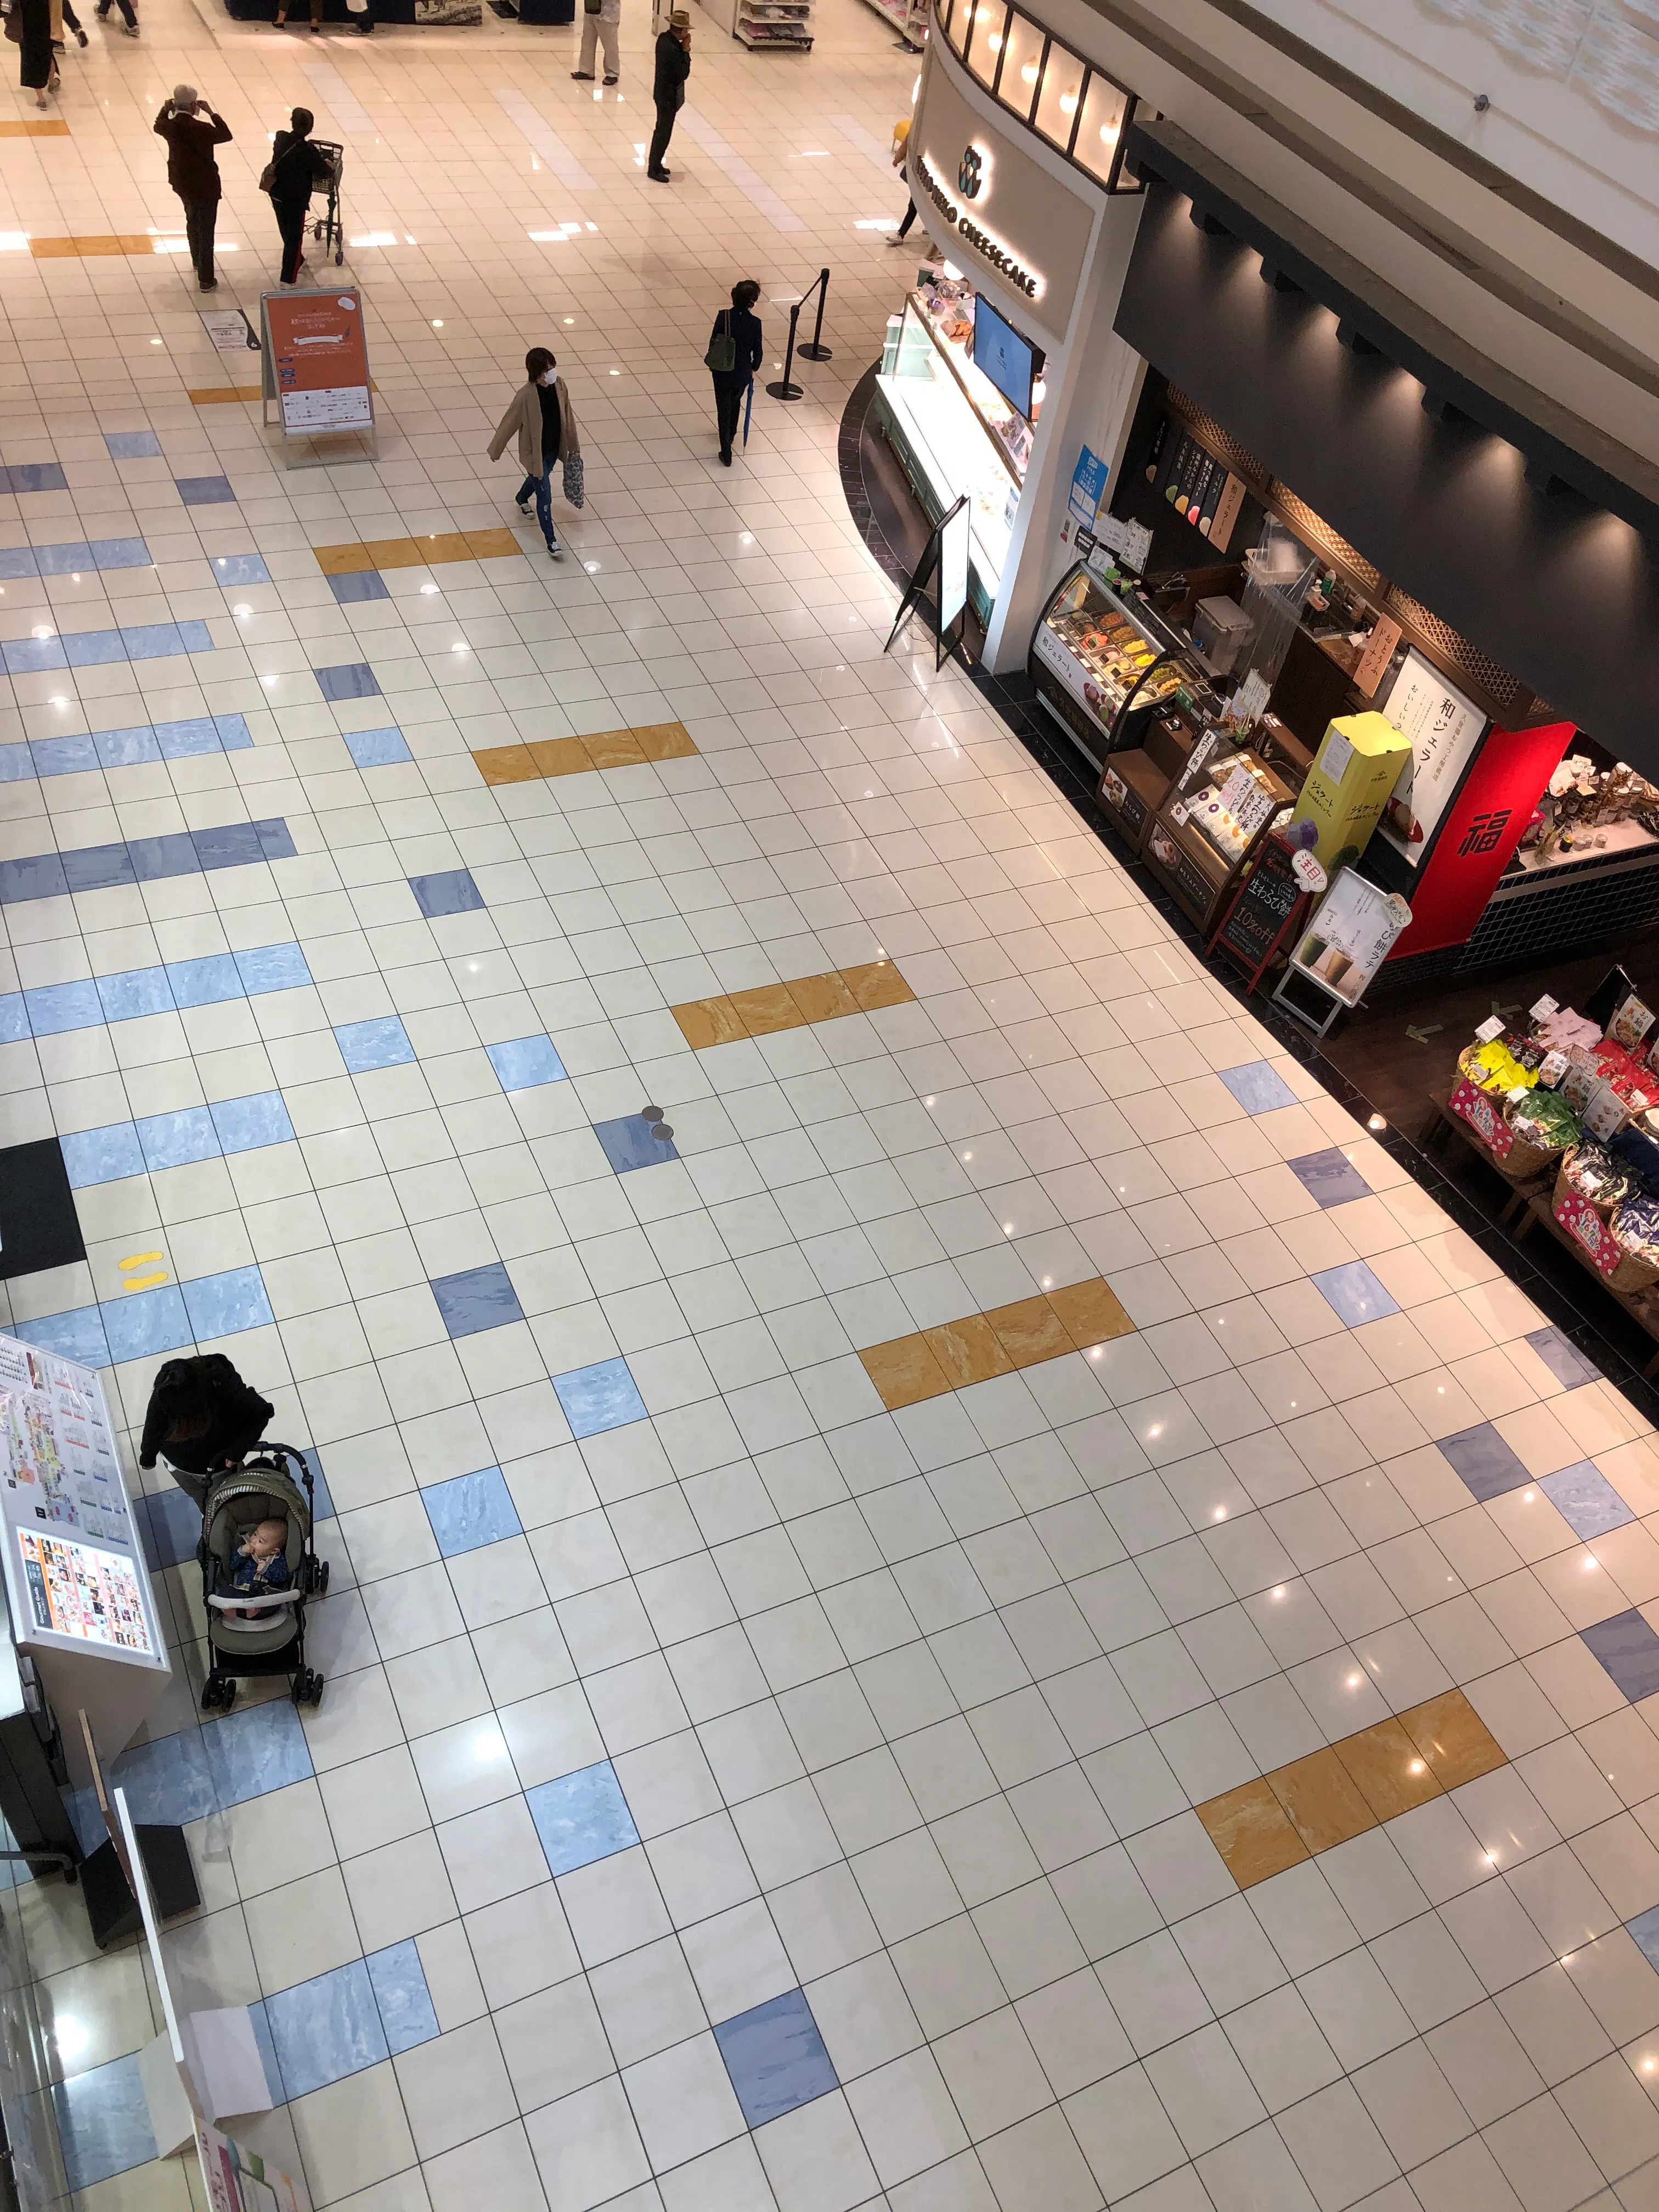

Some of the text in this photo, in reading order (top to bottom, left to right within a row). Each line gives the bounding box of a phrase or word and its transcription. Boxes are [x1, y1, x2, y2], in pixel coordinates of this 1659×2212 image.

[959, 218, 1036, 297] CHEESECAKE
[1042, 636, 1070, 672] 和ジェラート
[1364, 628, 1387, 667] ドーナツ
[1370, 635, 1393, 675] おとうふ
[1406, 697, 1457, 795] 和ジェラート
[1457, 809, 1513, 857] 福
[1248, 878, 1292, 918] 生わらび餅
